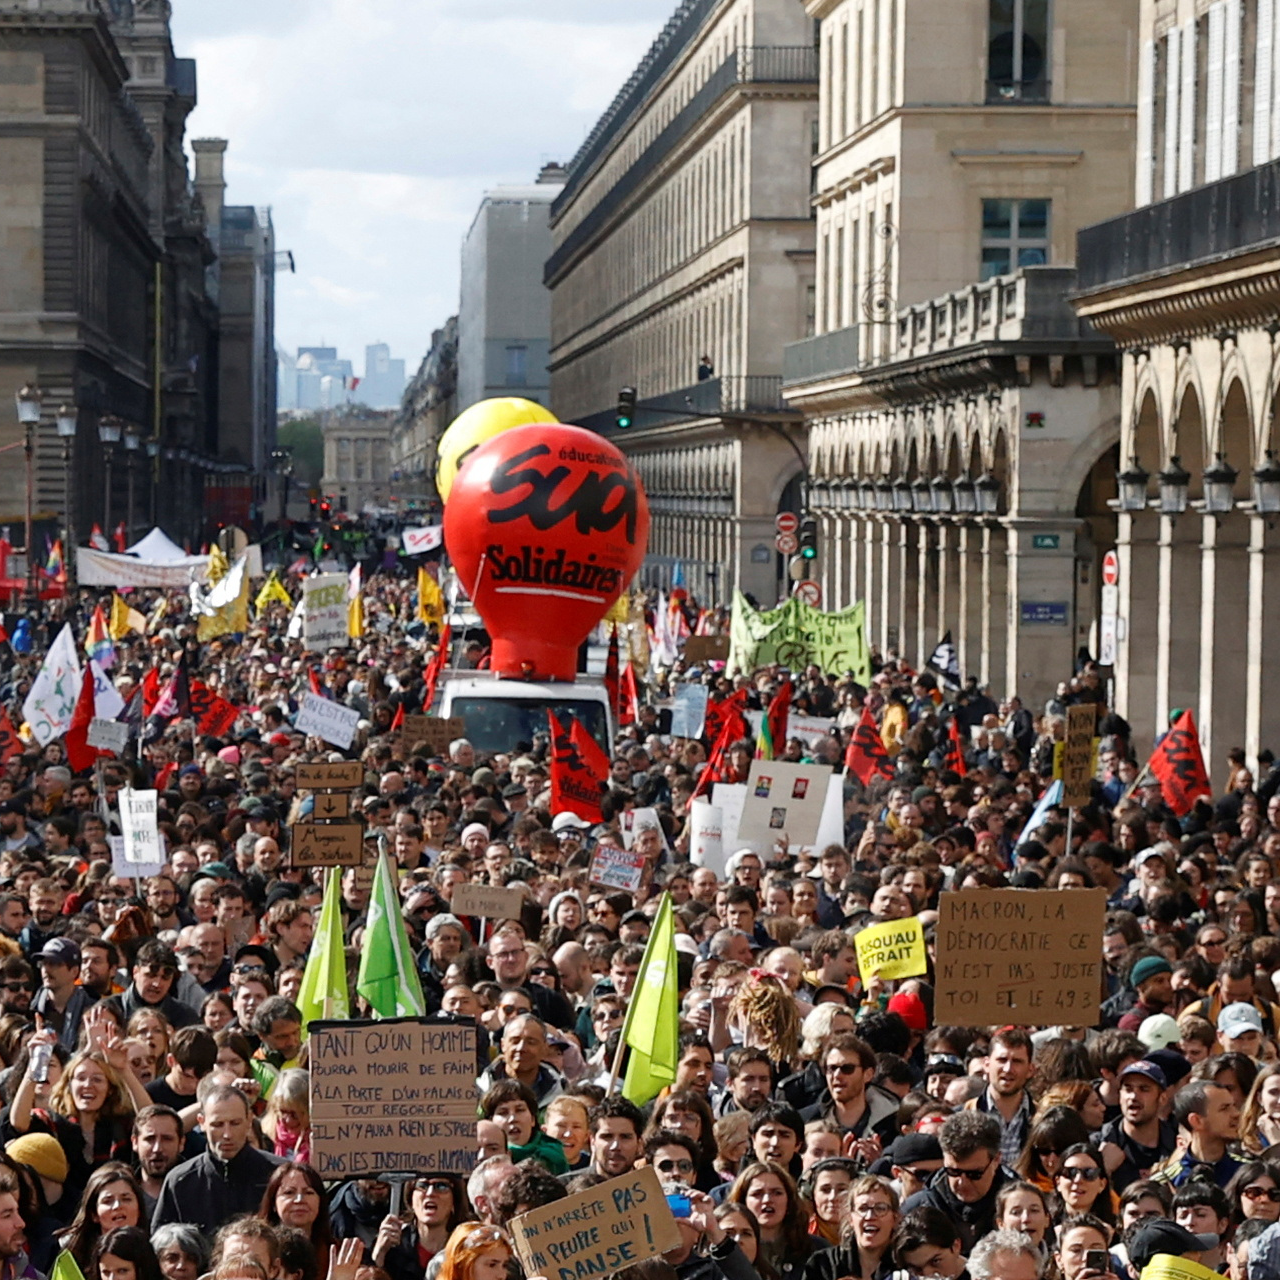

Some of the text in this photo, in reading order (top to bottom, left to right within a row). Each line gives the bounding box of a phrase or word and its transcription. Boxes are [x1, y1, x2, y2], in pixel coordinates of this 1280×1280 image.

[486, 545, 624, 593] Solidaires
[950, 901, 1066, 924] MACRON, LA
[946, 928, 1091, 952] DÉMOCRATIE CE
[943, 961, 1095, 980] N'EST PAS JUSTE
[947, 990, 980, 1007] TOI
[996, 990, 1016, 1008] ET
[1029, 990, 1043, 1007] LE
[316, 1028, 477, 1059] TANT QU'UN HOMME
[311, 1060, 357, 1077] POURRA
[367, 1062, 409, 1076] MOURIR
[419, 1063, 436, 1076] DE
[325, 1087, 343, 1100] LA
[348, 1084, 383, 1101] PORTE
[393, 1086, 420, 1101] D'UN
[424, 1086, 462, 1100] PALAIS
[342, 1104, 449, 1117] TOUT REGORGE,
[312, 1120, 477, 1141] IL N'Y AURA RIEN DE STABLE
[318, 1151, 347, 1173] DANS
[349, 1151, 369, 1172] LES
[371, 1151, 435, 1170] INSTITUTIONS
[522, 1182, 647, 1239] ON N'ARRÊTE PAS
[643, 1213, 656, 1251] !
[526, 1254, 547, 1272] UN
[547, 1226, 600, 1264] PEUPLE
